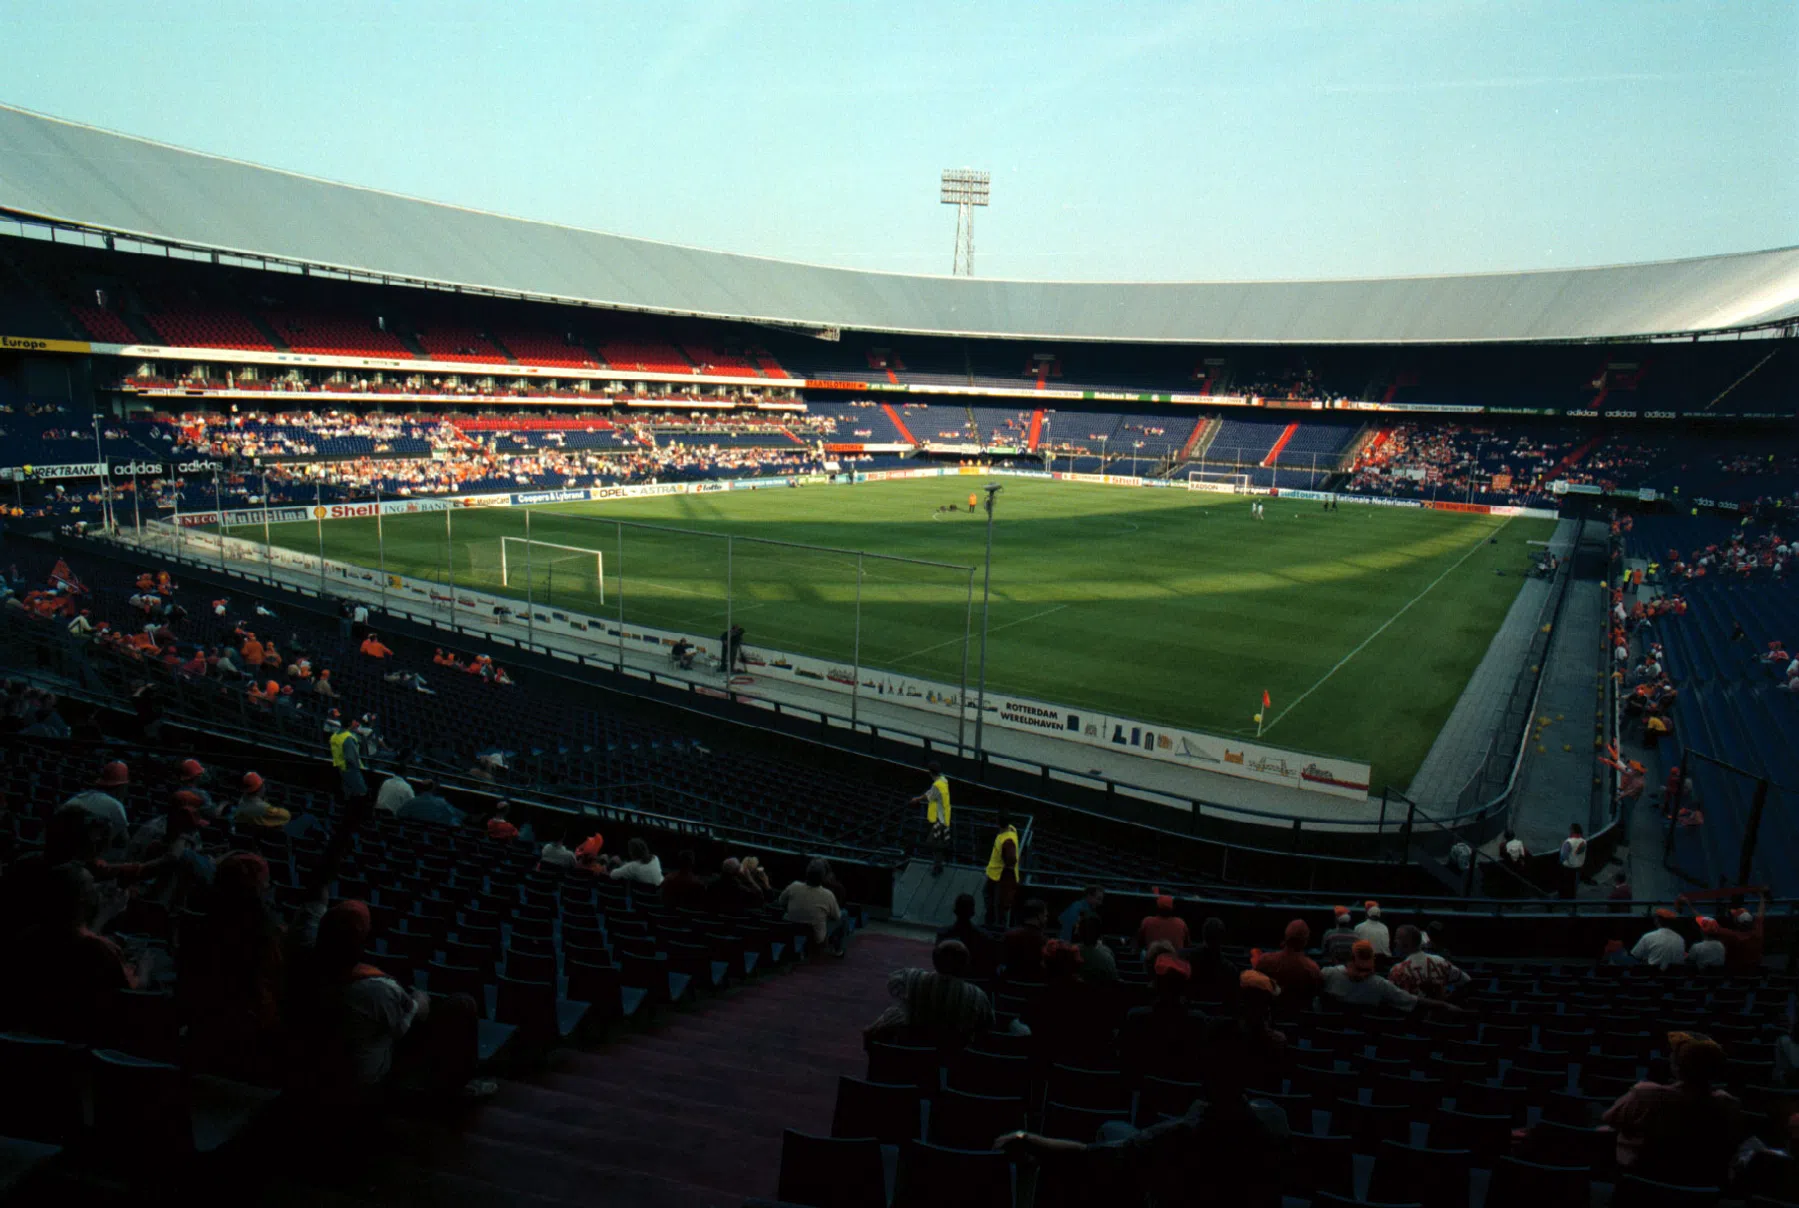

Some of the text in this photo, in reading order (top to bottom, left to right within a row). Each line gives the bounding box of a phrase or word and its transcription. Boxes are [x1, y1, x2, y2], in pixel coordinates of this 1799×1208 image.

[2, 336, 48, 350] Europe
[1566, 409, 1599, 417] adidas
[1605, 410, 1637, 418] adidas
[1644, 410, 1676, 419] adidas
[114, 460, 162, 475] adidas
[178, 459, 223, 473] adidas
[518, 494, 549, 504] Coopers
[556, 490, 584, 501] Lybrand
[600, 485, 677, 498] OPEL ASTRA
[477, 496, 510, 505] MasterCard
[331, 503, 379, 518] Shell
[384, 502, 448, 514] ING BANK
[223, 508, 305, 524] Multiclima
[1006, 702, 1058, 719] ROTTERDAM
[1000, 711, 1064, 730] WERELDHAVEN
